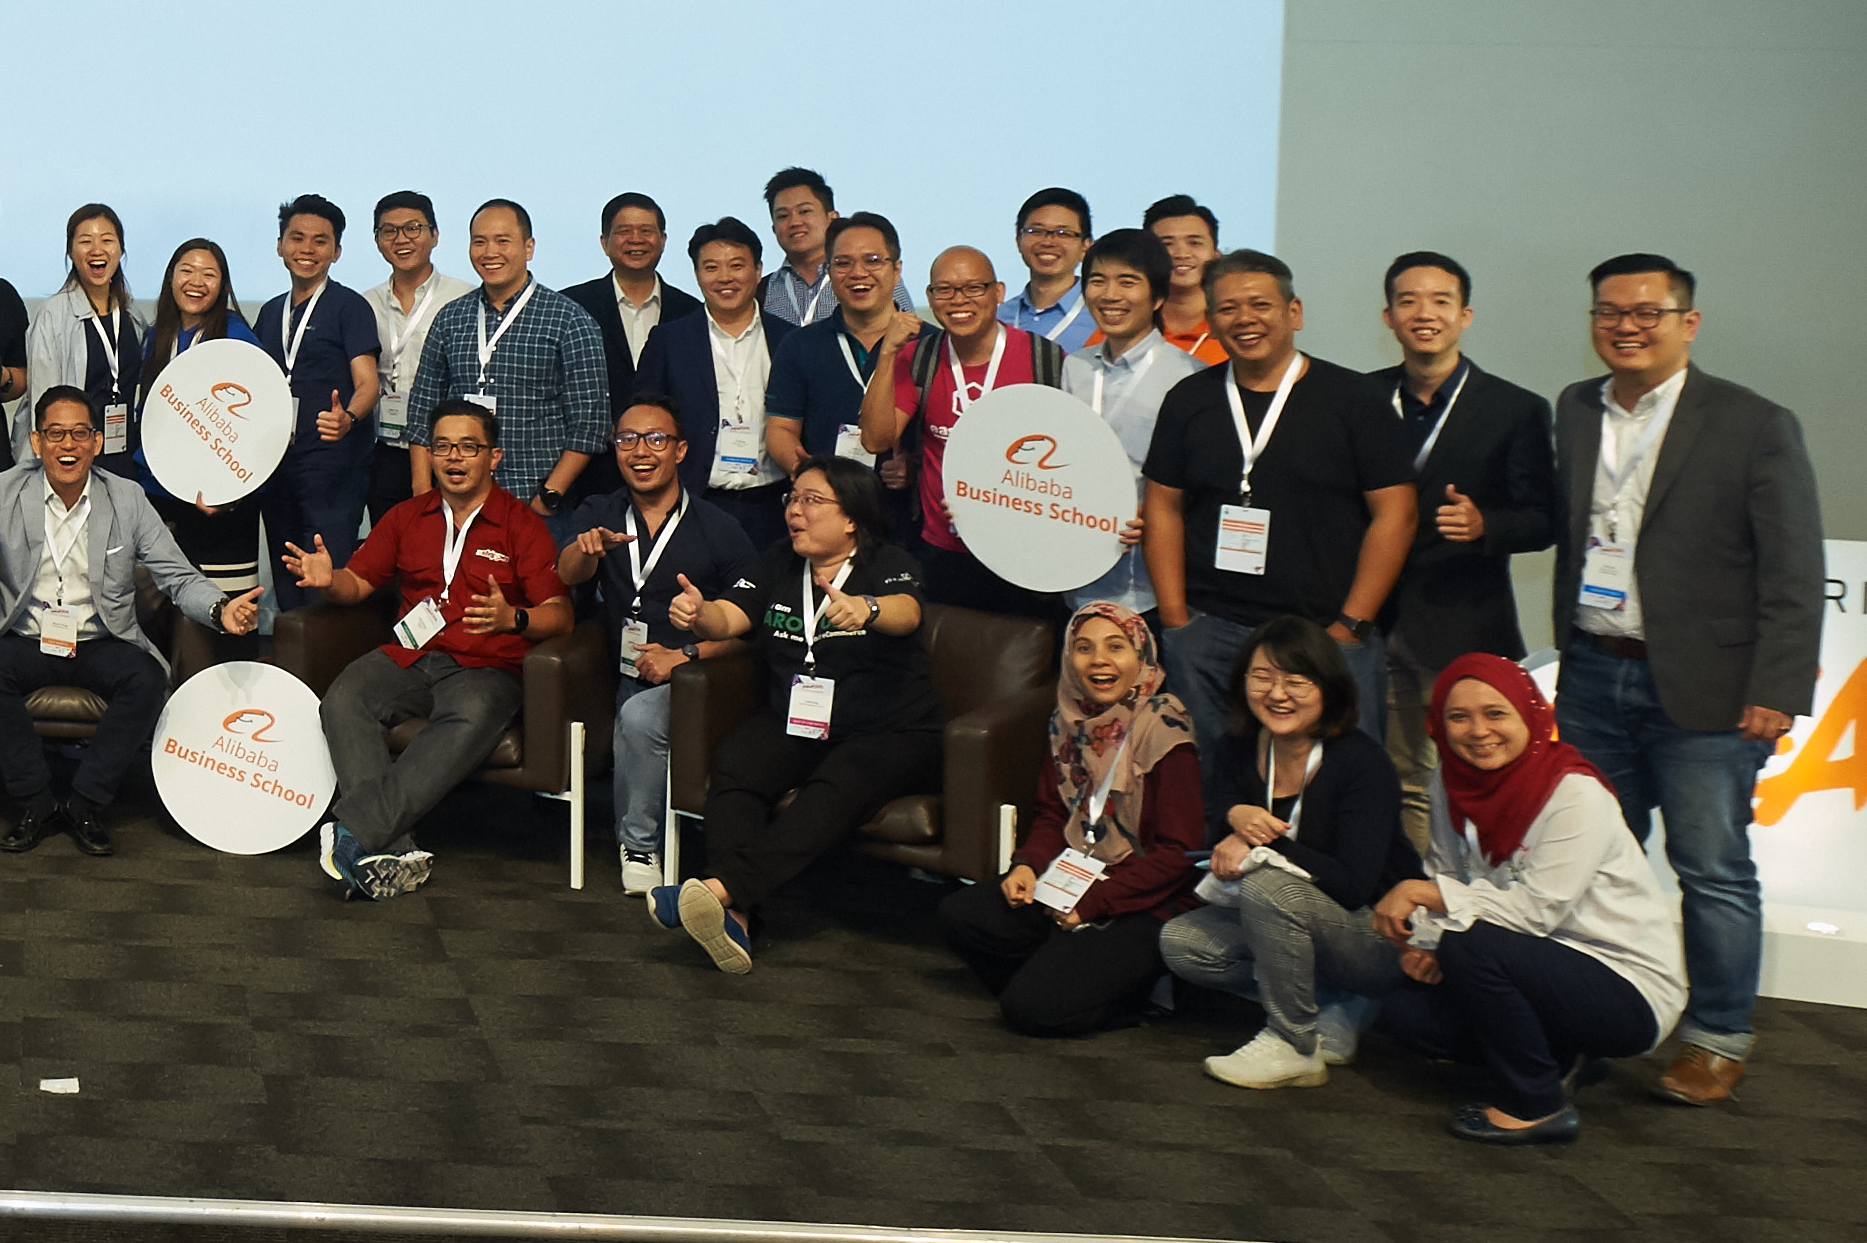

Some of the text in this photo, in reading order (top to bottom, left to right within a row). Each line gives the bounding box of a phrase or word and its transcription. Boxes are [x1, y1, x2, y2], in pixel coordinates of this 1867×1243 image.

[159, 383, 254, 484] Business School
[196, 397, 239, 443] Alibaba
[956, 480, 1119, 534] Business School
[1001, 469, 1073, 499] Alibaba
[164, 737, 315, 810] Business School
[212, 735, 279, 772] Alibaba
